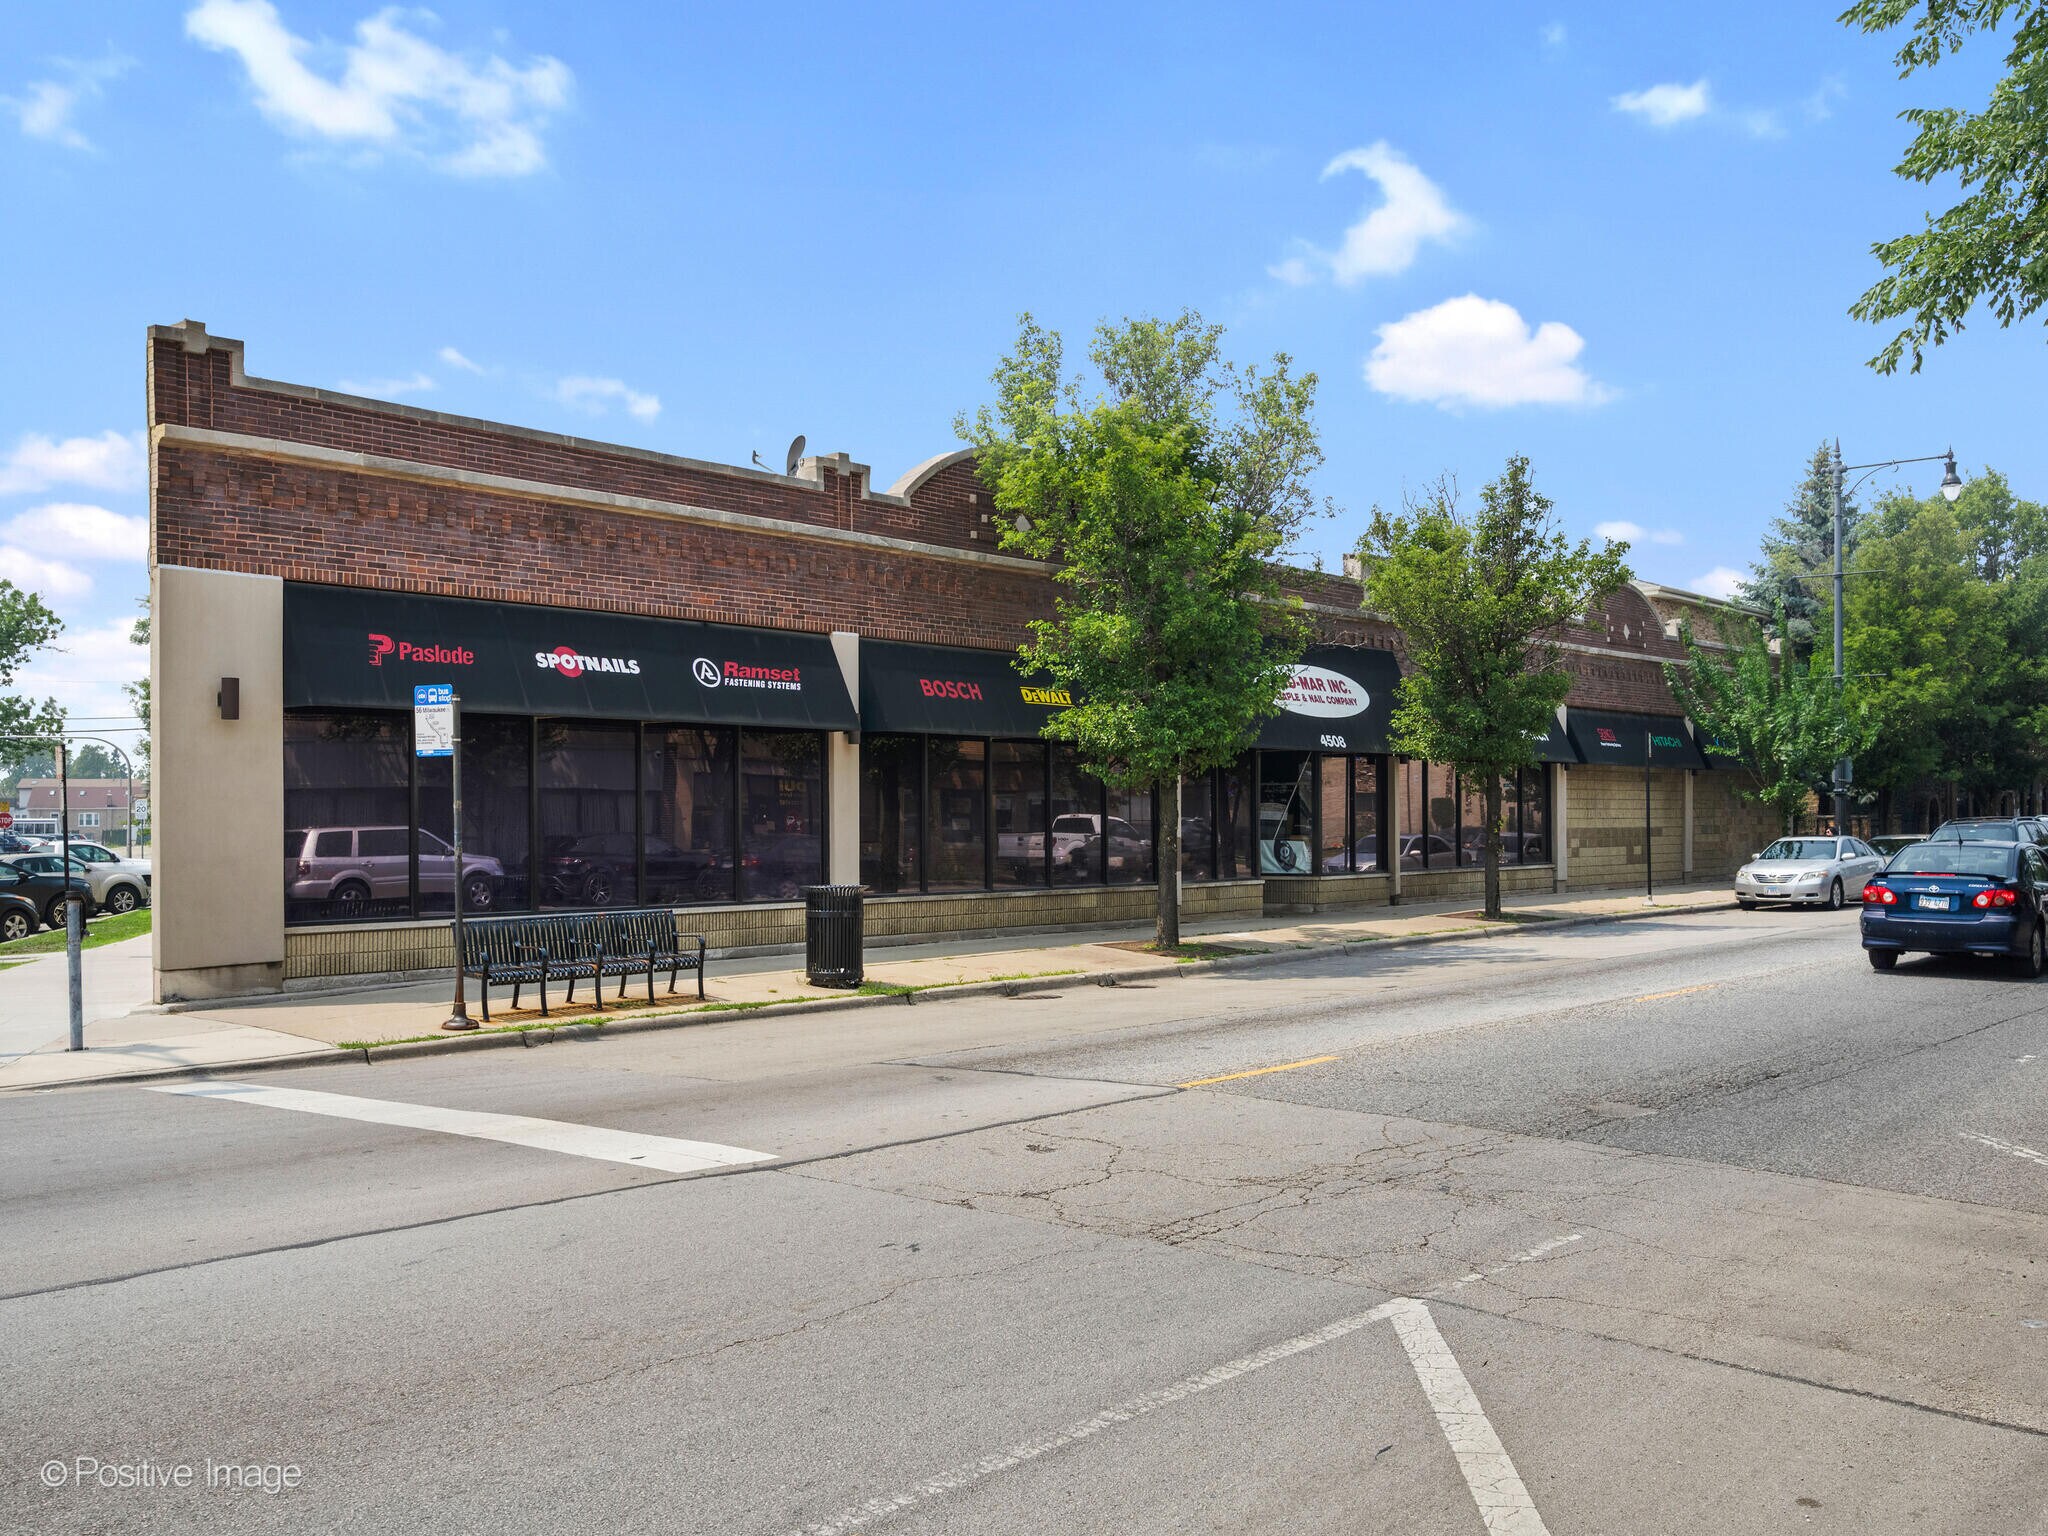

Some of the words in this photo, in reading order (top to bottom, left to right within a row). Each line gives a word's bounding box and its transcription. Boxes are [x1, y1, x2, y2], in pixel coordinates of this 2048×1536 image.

[399, 641, 474, 665] Paslode
[535, 652, 640, 675] SPOTNAILS
[723, 661, 800, 682] Ramset
[724, 678, 765, 689] FASTENING
[767, 681, 801, 691] SYSTEMS
[919, 678, 984, 700] BOSCH
[1327, 679, 1352, 694] INC.
[1302, 694, 1308, 702] &
[1308, 694, 1325, 704] NAIL
[1326, 696, 1358, 706] COMPANY
[1320, 734, 1347, 749] 4508
[1652, 735, 1682, 748] HITACHI
